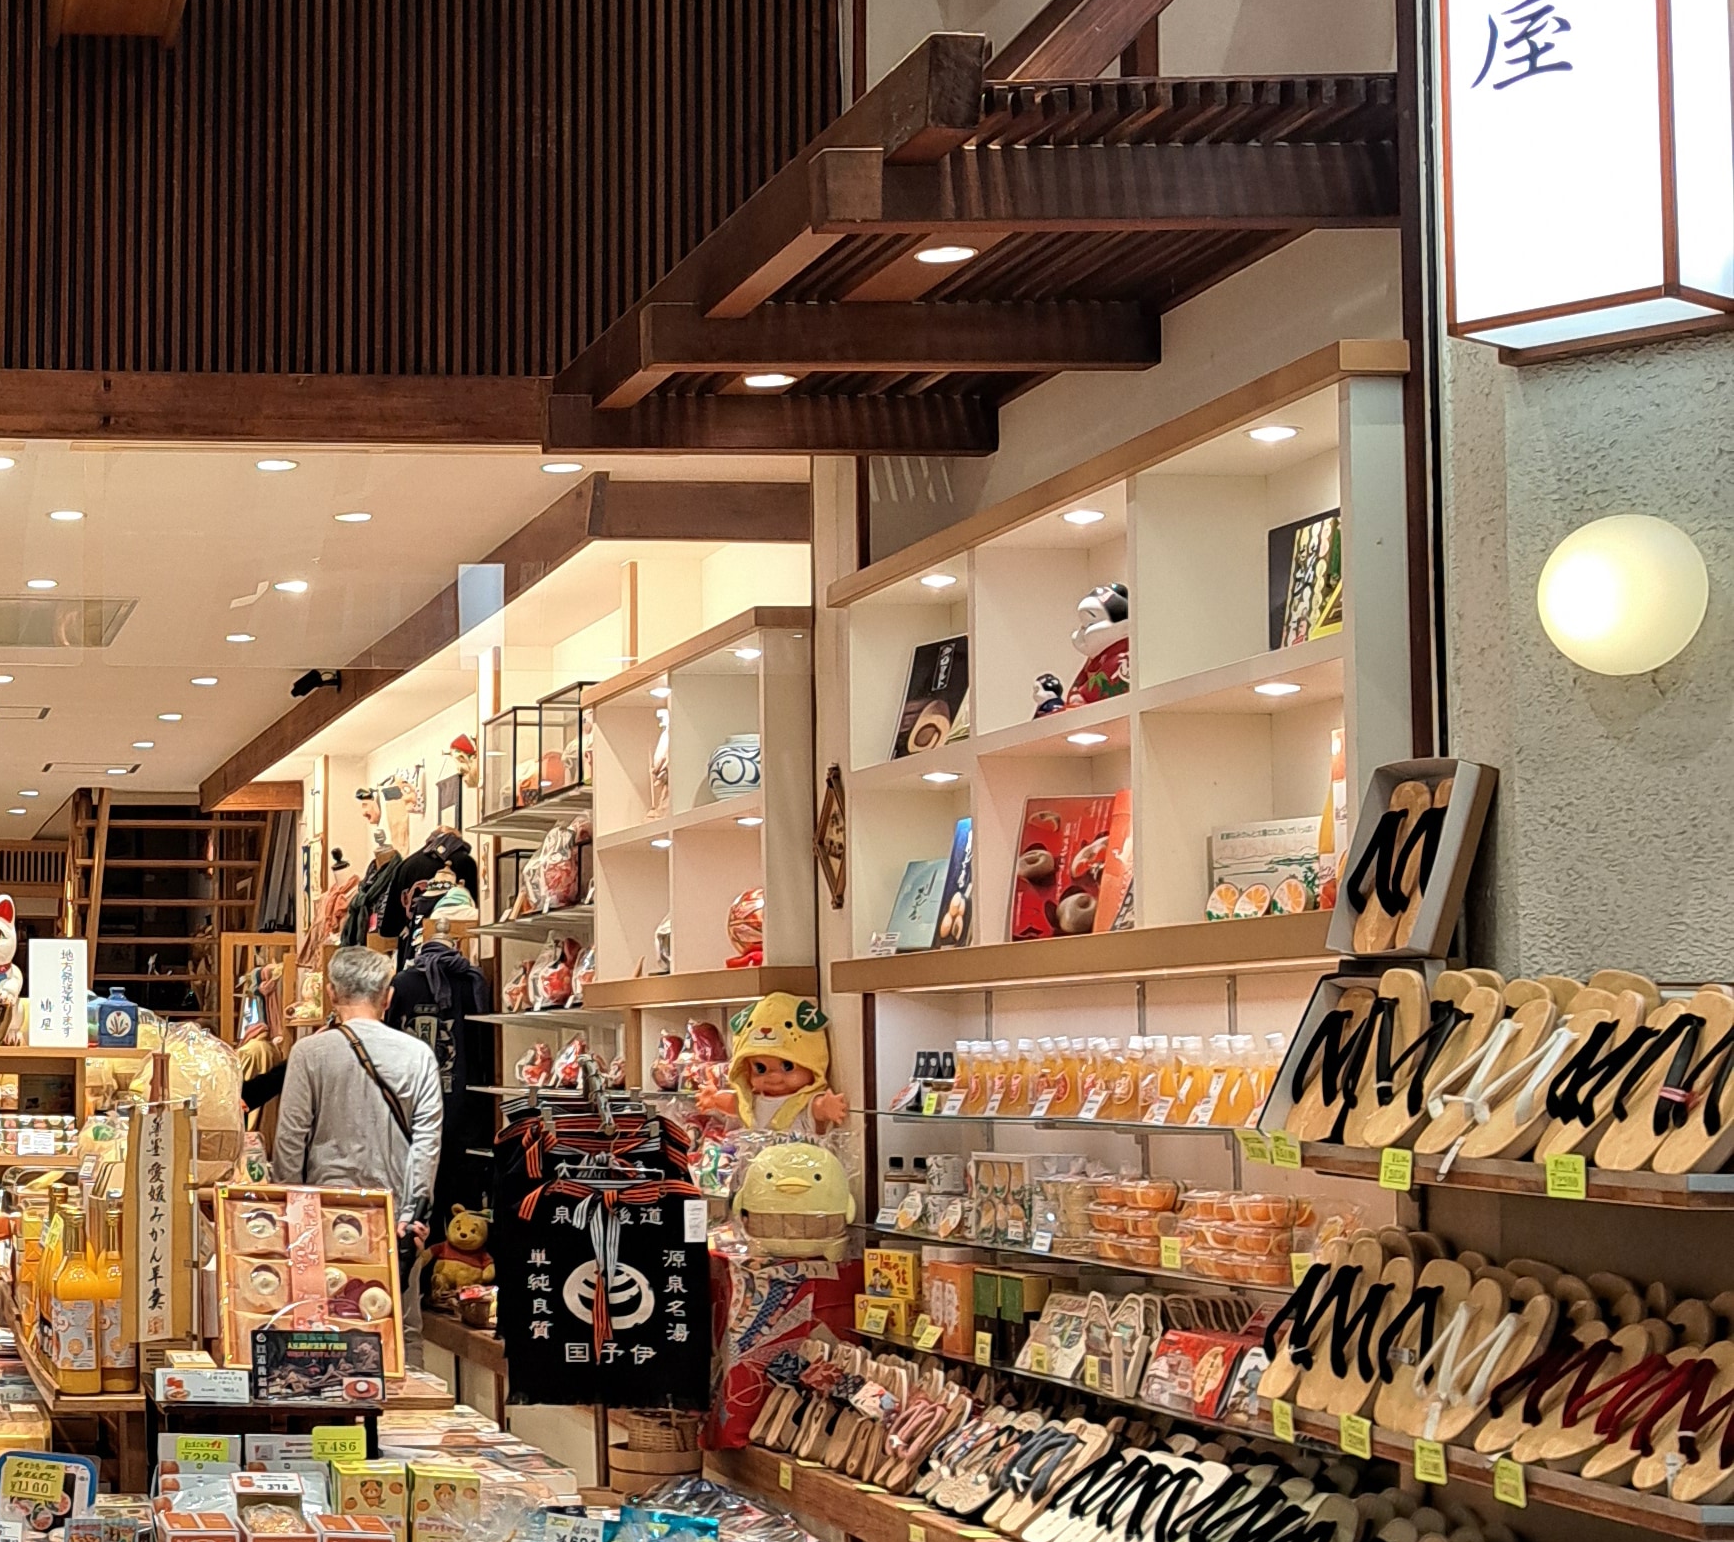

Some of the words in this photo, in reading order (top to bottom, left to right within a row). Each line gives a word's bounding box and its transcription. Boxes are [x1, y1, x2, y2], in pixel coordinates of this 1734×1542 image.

[551, 1205, 664, 1225] 道後泉
[526, 1248, 553, 1340] 単純良質
[662, 1249, 690, 1342] 源泉名湯
